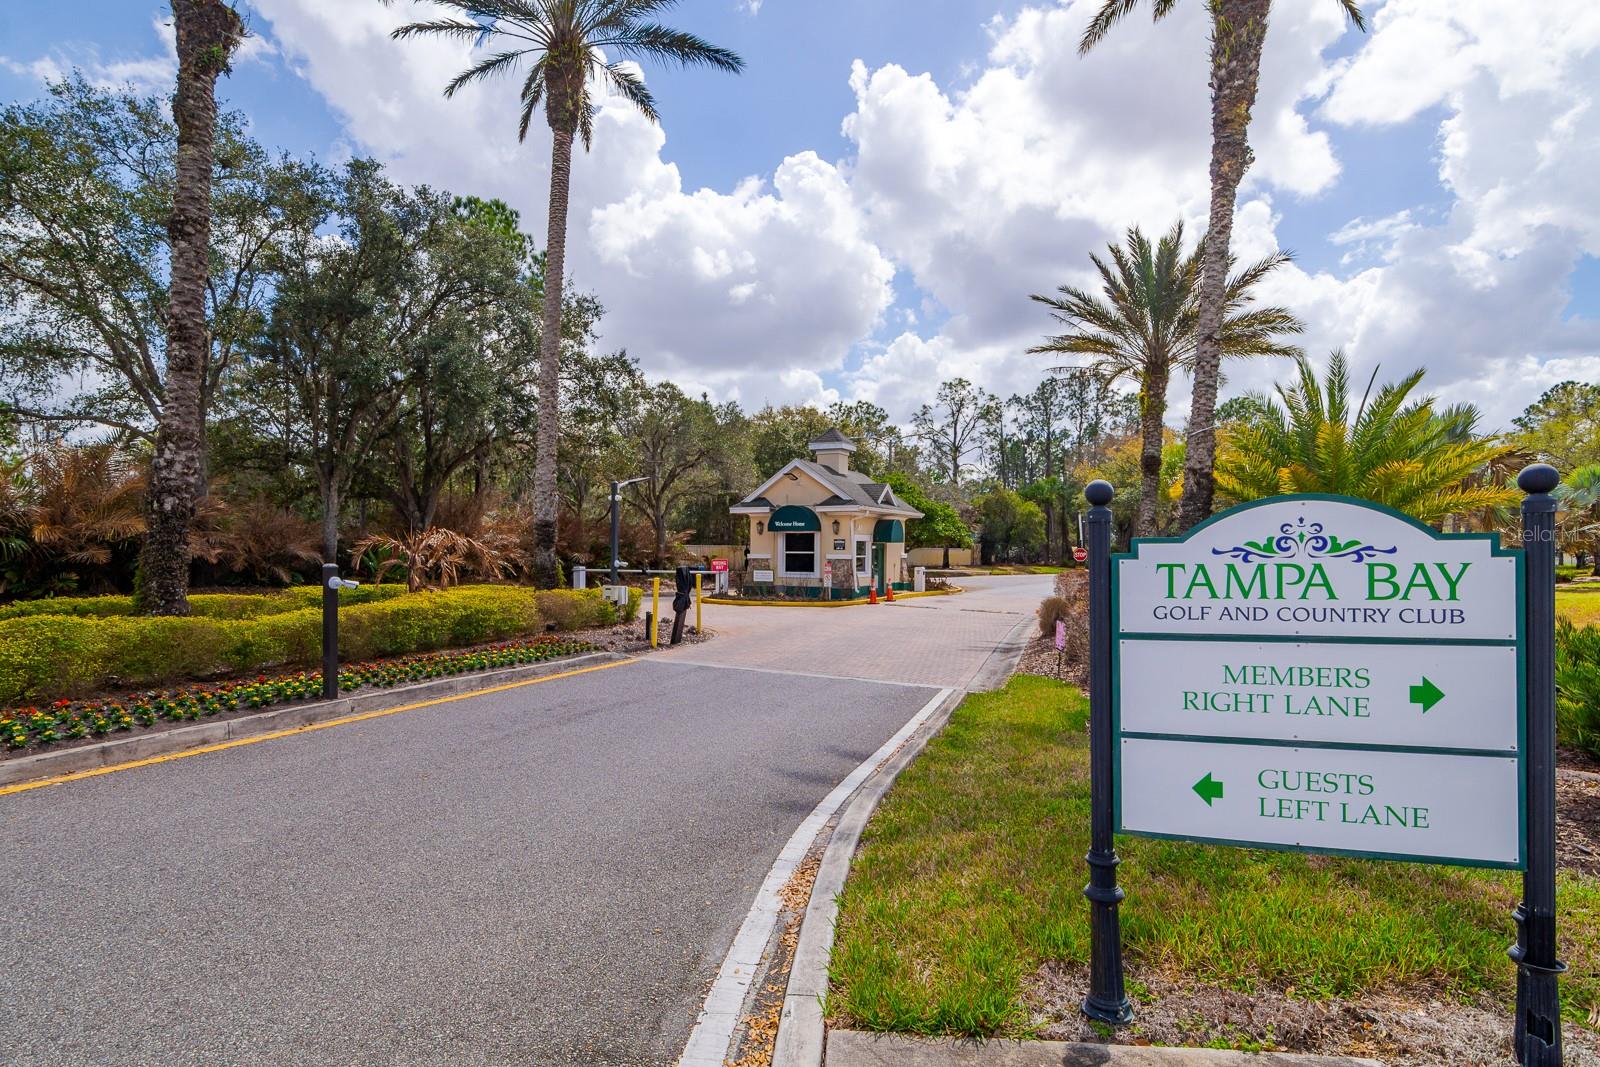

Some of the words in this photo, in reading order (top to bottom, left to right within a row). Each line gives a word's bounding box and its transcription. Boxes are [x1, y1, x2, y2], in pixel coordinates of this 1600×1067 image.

[1155, 563, 1339, 601] TAMPA
[1365, 562, 1472, 601] BAY
[1153, 605, 1212, 621] GOLF
[1219, 606, 1268, 622] AND
[1277, 607, 1391, 624] COUNTRY
[1398, 608, 1466, 625] CLUB
[1223, 664, 1370, 688] MEMBERS
[1182, 691, 1274, 714] RIGHT
[1284, 694, 1371, 718] LANE
[1258, 769, 1374, 795] GUESTS
[1259, 797, 1329, 821] LEFT
[1340, 802, 1430, 829] LANE
